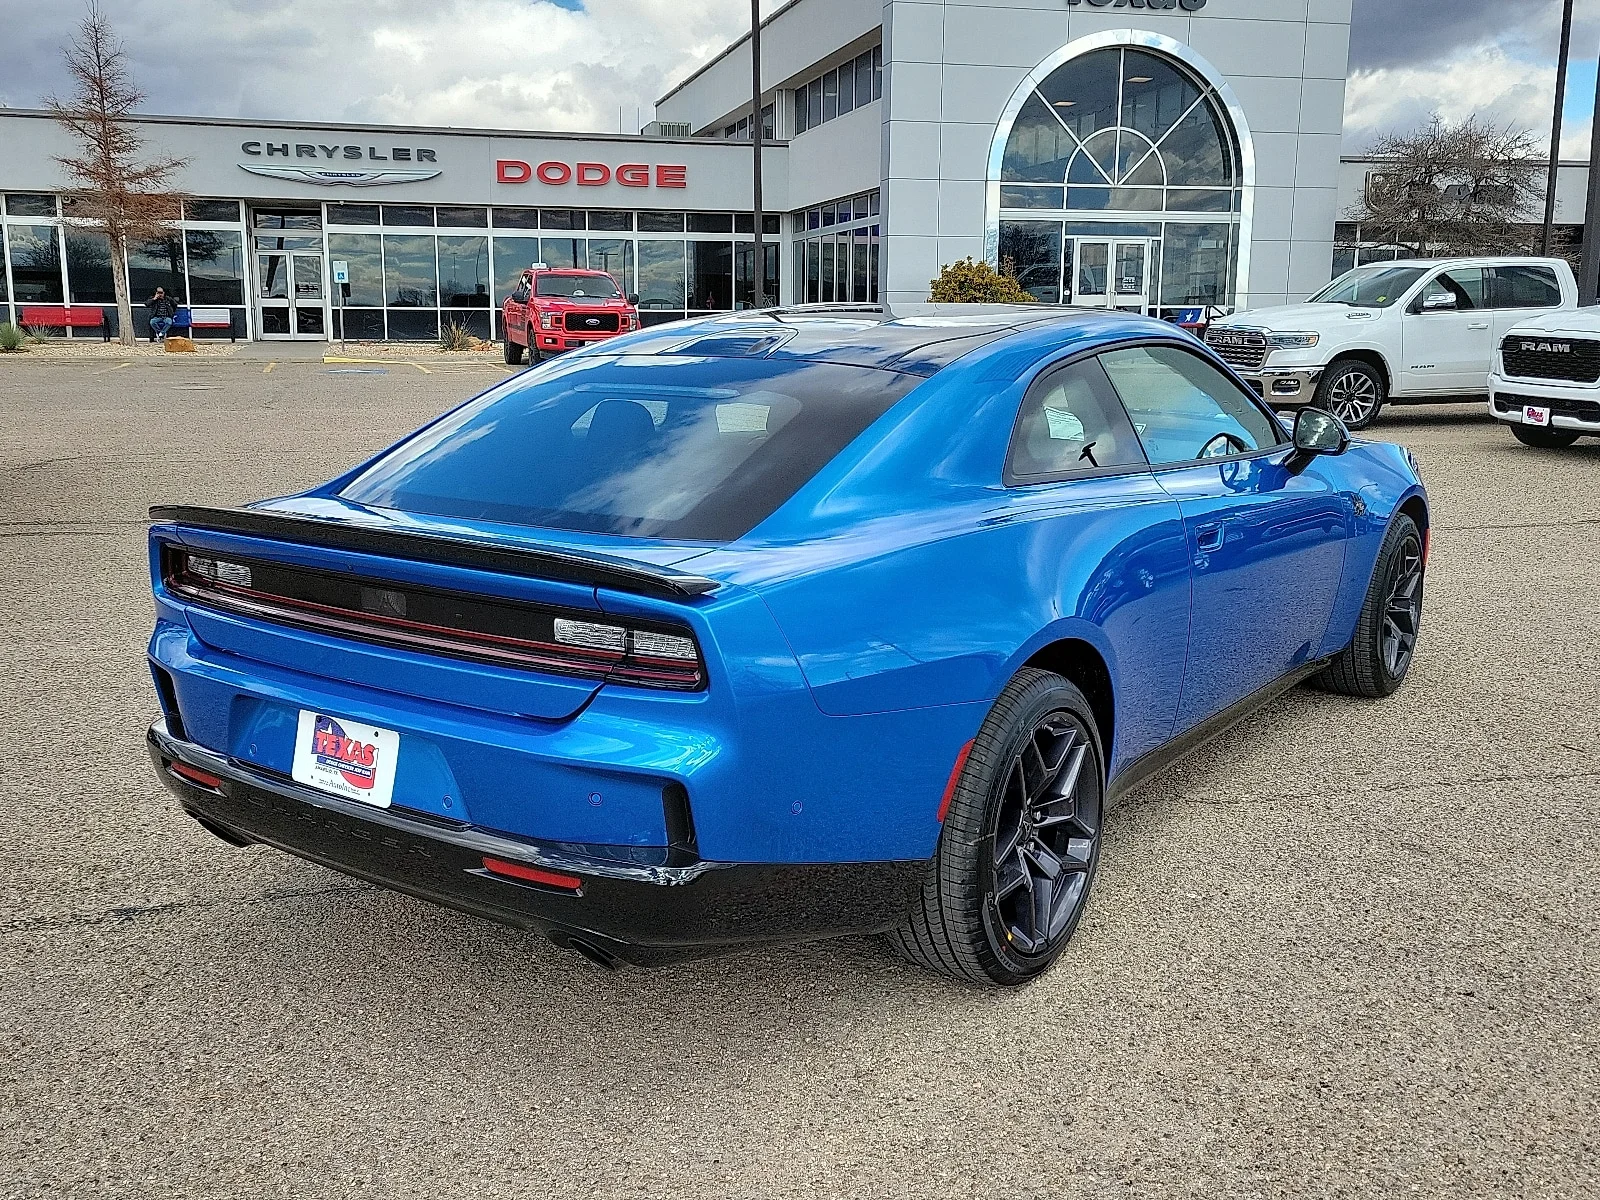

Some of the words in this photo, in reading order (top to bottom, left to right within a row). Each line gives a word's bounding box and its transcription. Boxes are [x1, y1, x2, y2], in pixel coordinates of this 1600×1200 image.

[241, 141, 437, 163] CHRYSLER
[496, 159, 687, 188] DODGE
[1521, 342, 1571, 353] RAM
[315, 731, 376, 767] TEXAS
